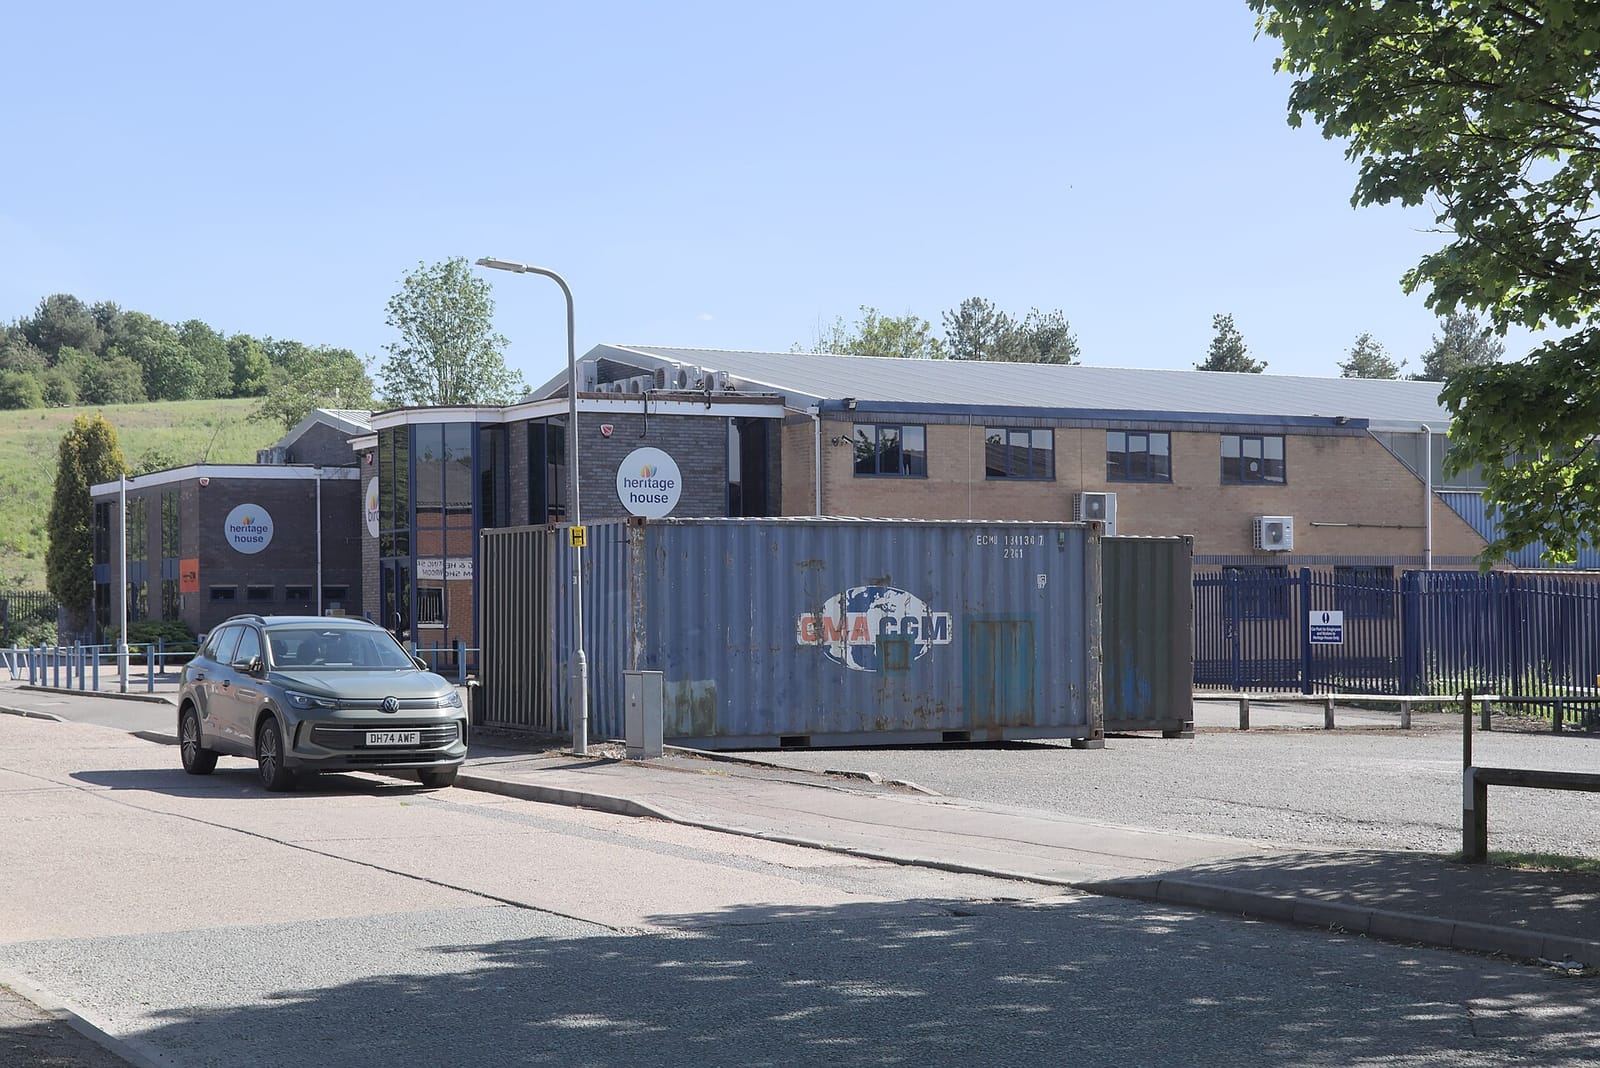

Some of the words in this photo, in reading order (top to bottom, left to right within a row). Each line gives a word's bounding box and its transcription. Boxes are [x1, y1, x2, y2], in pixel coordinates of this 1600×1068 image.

[623, 477, 675, 491] heritage
[630, 492, 669, 503] house
[230, 524, 269, 535] heritage
[234, 534, 264, 543] house
[572, 528, 584, 545] H
[801, 616, 871, 642] CMA
[370, 733, 395, 743] DH74
[397, 733, 416, 743] AWF
